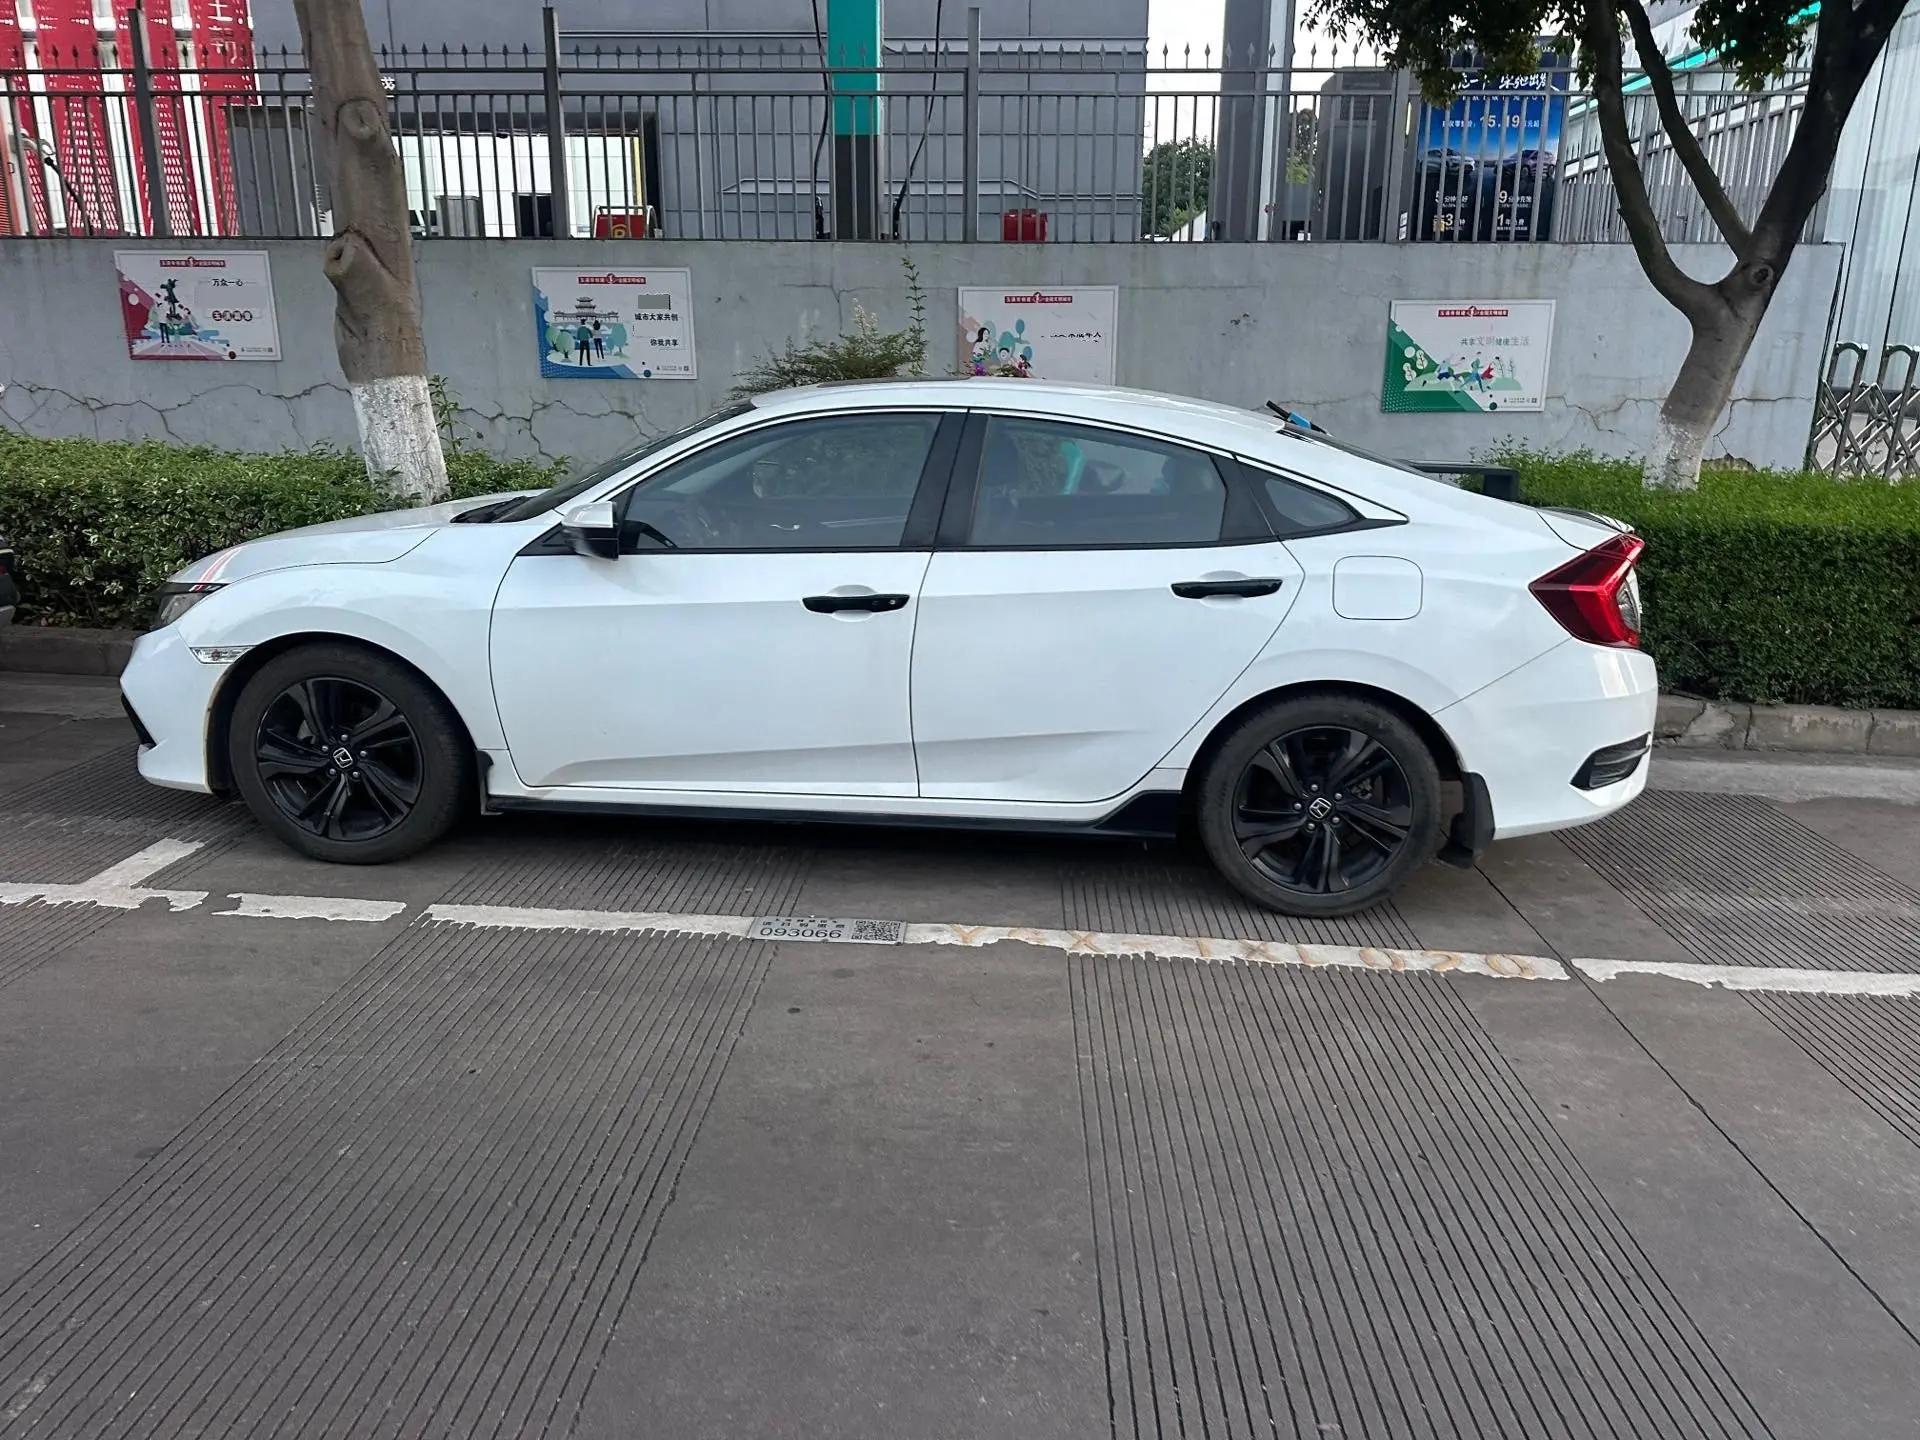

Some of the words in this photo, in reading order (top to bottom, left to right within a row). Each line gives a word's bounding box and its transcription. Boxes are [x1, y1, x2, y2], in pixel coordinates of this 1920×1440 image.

[211, 278, 244, 287] 万众一心
[759, 927, 843, 939] 093066
